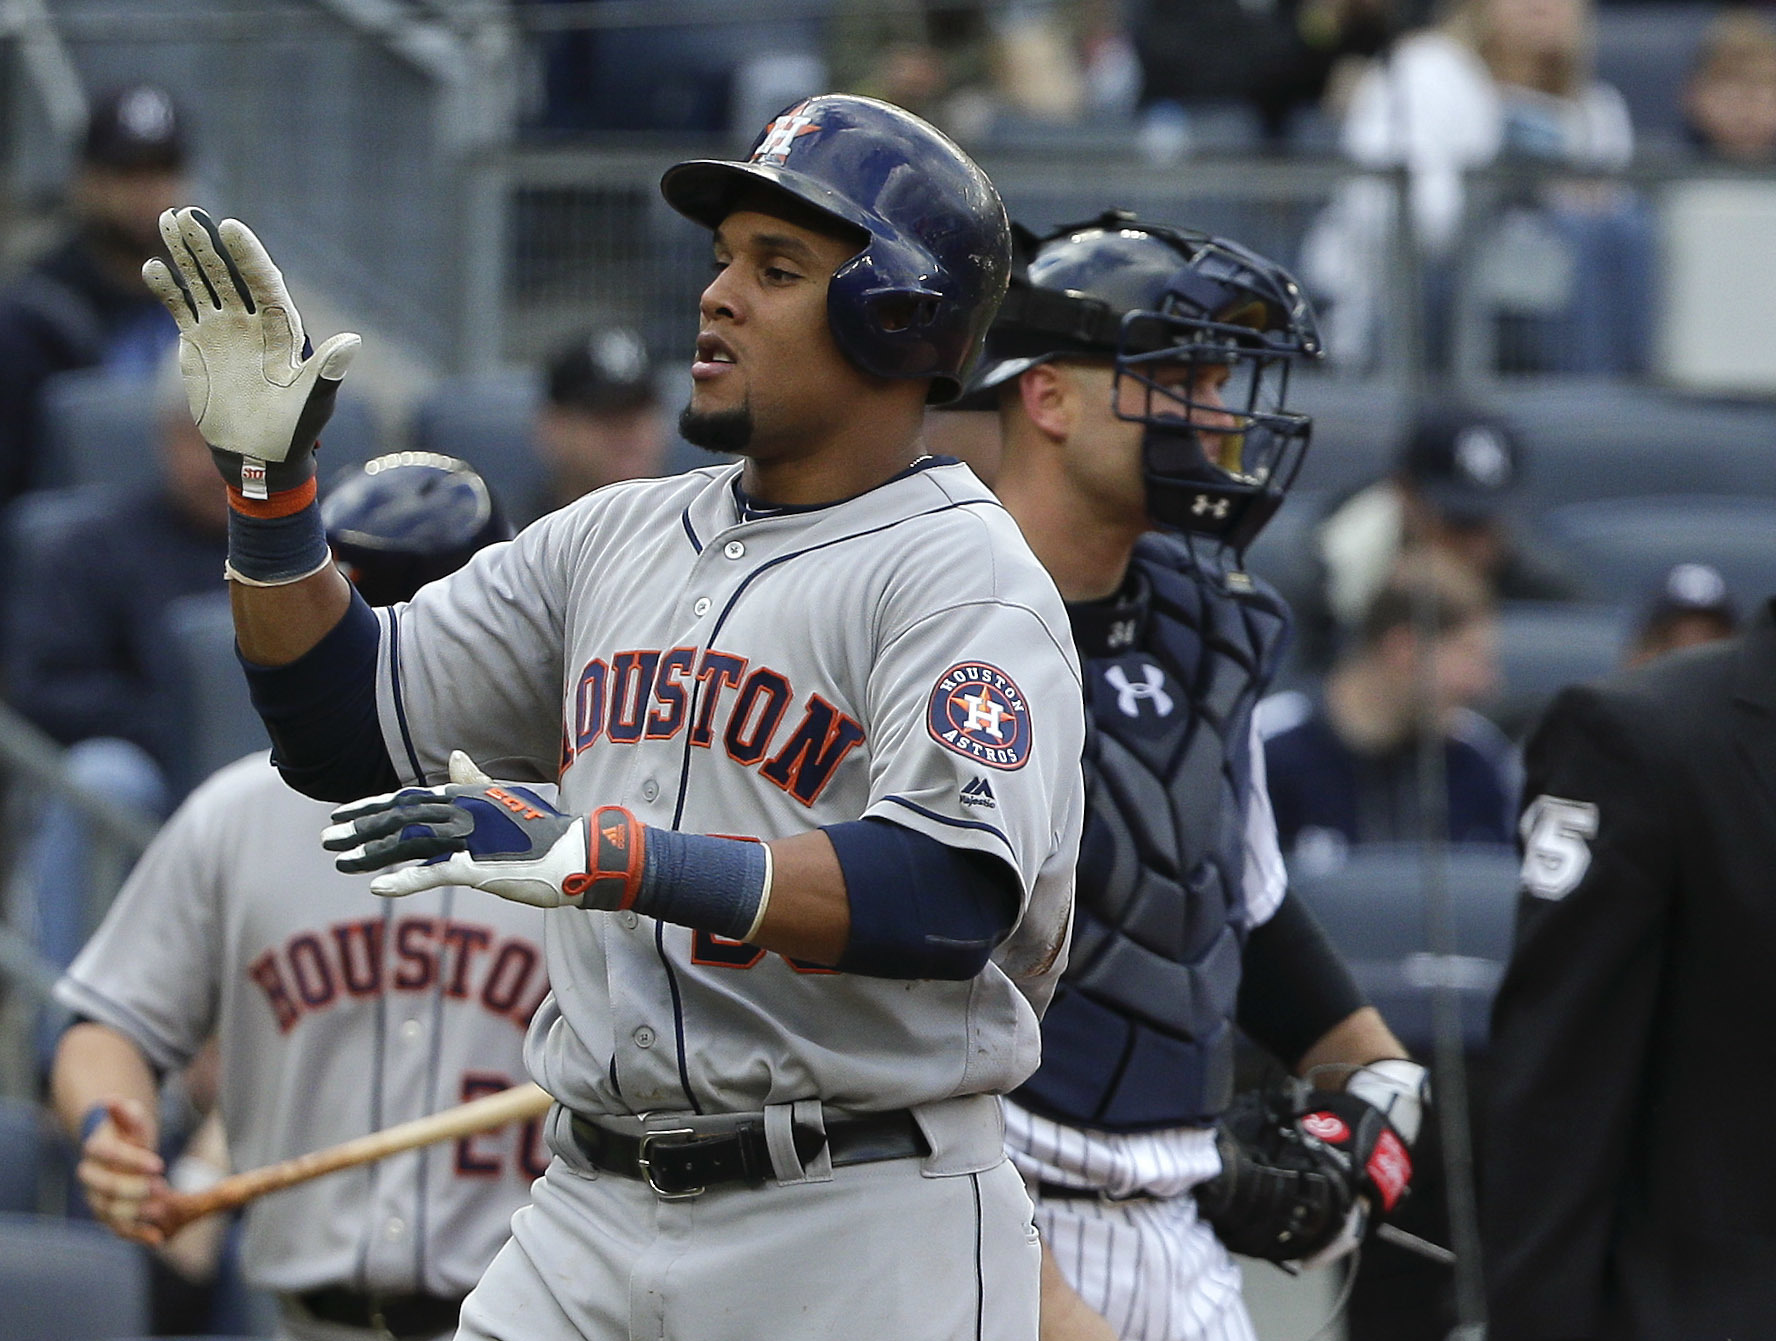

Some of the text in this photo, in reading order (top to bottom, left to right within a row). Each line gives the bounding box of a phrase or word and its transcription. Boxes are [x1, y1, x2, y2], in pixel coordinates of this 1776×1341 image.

[940, 667, 1025, 712] HOUSTON
[558, 646, 867, 808] OUSTON
[963, 693, 1005, 739] H
[942, 729, 1018, 763] ASTROS
